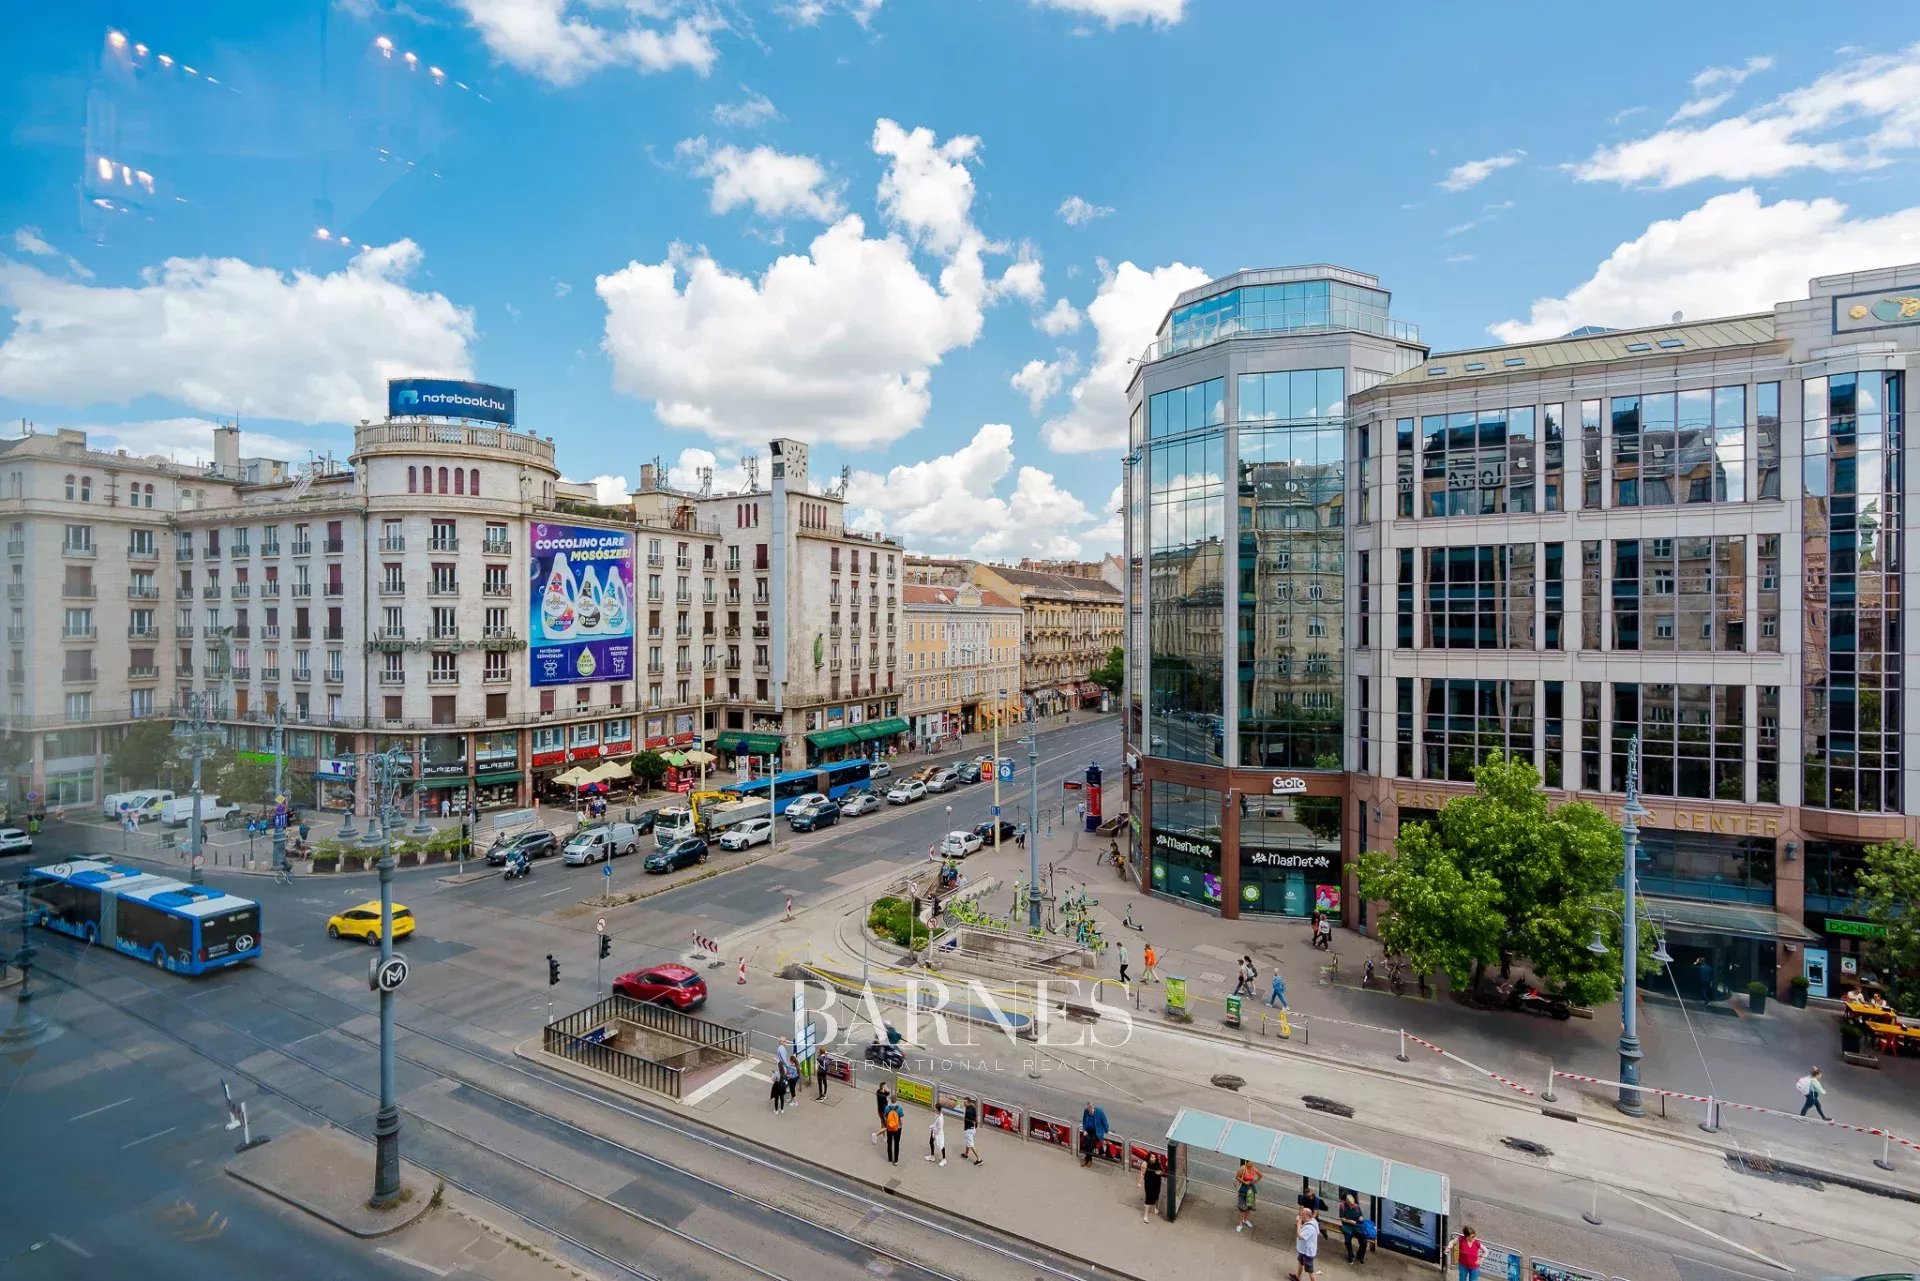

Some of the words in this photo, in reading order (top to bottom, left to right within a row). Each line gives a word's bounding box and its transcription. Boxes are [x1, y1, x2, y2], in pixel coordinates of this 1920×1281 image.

[423, 393, 505, 411] notebook.hu
[535, 538, 598, 550] COCCOLINO
[599, 536, 625, 547] CARE
[570, 546, 632, 561] MOSÓSZER!
[1673, 810, 1781, 837] CENTER
[1267, 852, 1315, 868] MagNet
